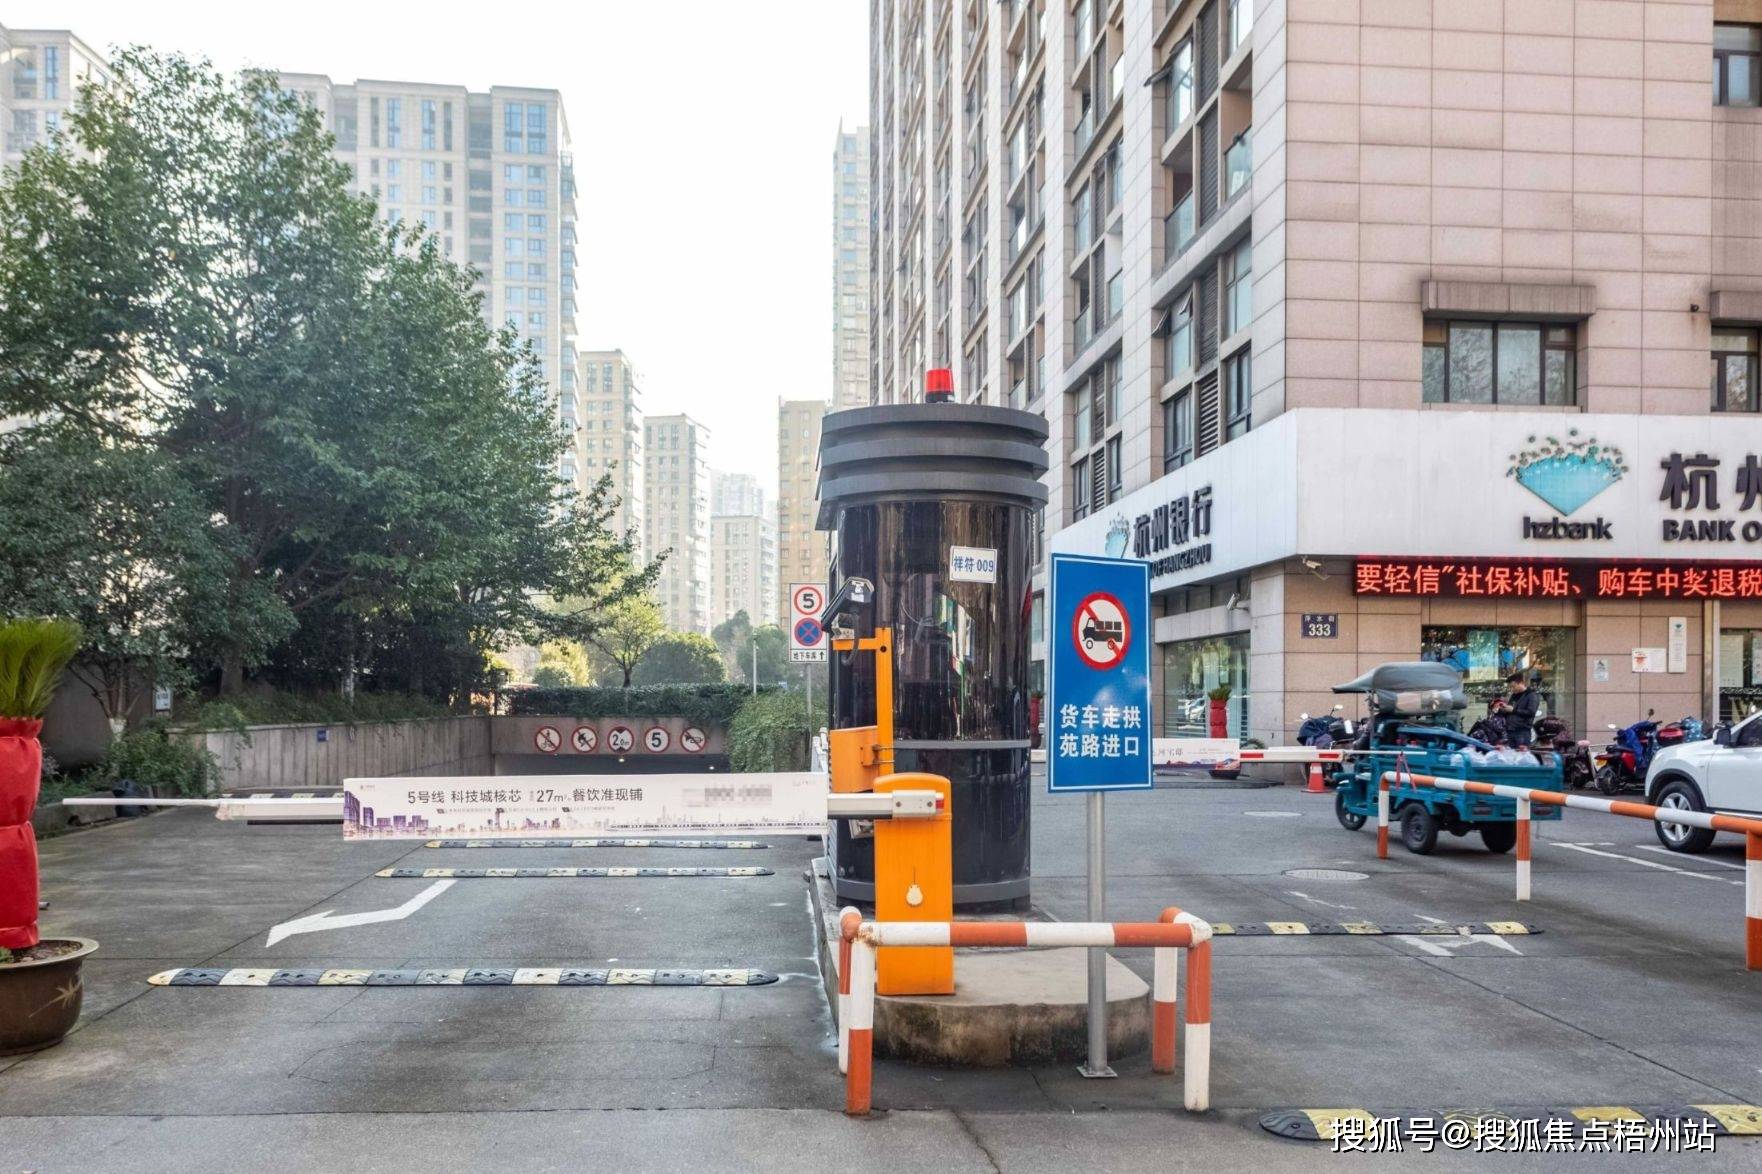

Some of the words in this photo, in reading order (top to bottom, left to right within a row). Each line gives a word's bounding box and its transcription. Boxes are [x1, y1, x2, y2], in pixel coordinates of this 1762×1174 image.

[1133, 485, 1213, 559] 杭州银行
[1522, 516, 1614, 540] hzbank
[1662, 519, 1737, 542] BANK
[953, 555, 975, 573] 祥符
[976, 559, 995, 573] 009
[1163, 543, 1213, 575] HANGZHOU
[802, 593, 815, 609] 5
[1308, 623, 1331, 637] 333
[1059, 703, 1142, 730] 货车走拱
[651, 731, 663, 748] 5
[1059, 732, 1140, 759] 苑路进口
[407, 790, 446, 804] 5号线
[450, 789, 522, 804] 科技城核芯
[572, 788, 644, 802] 餐饮准现铺
